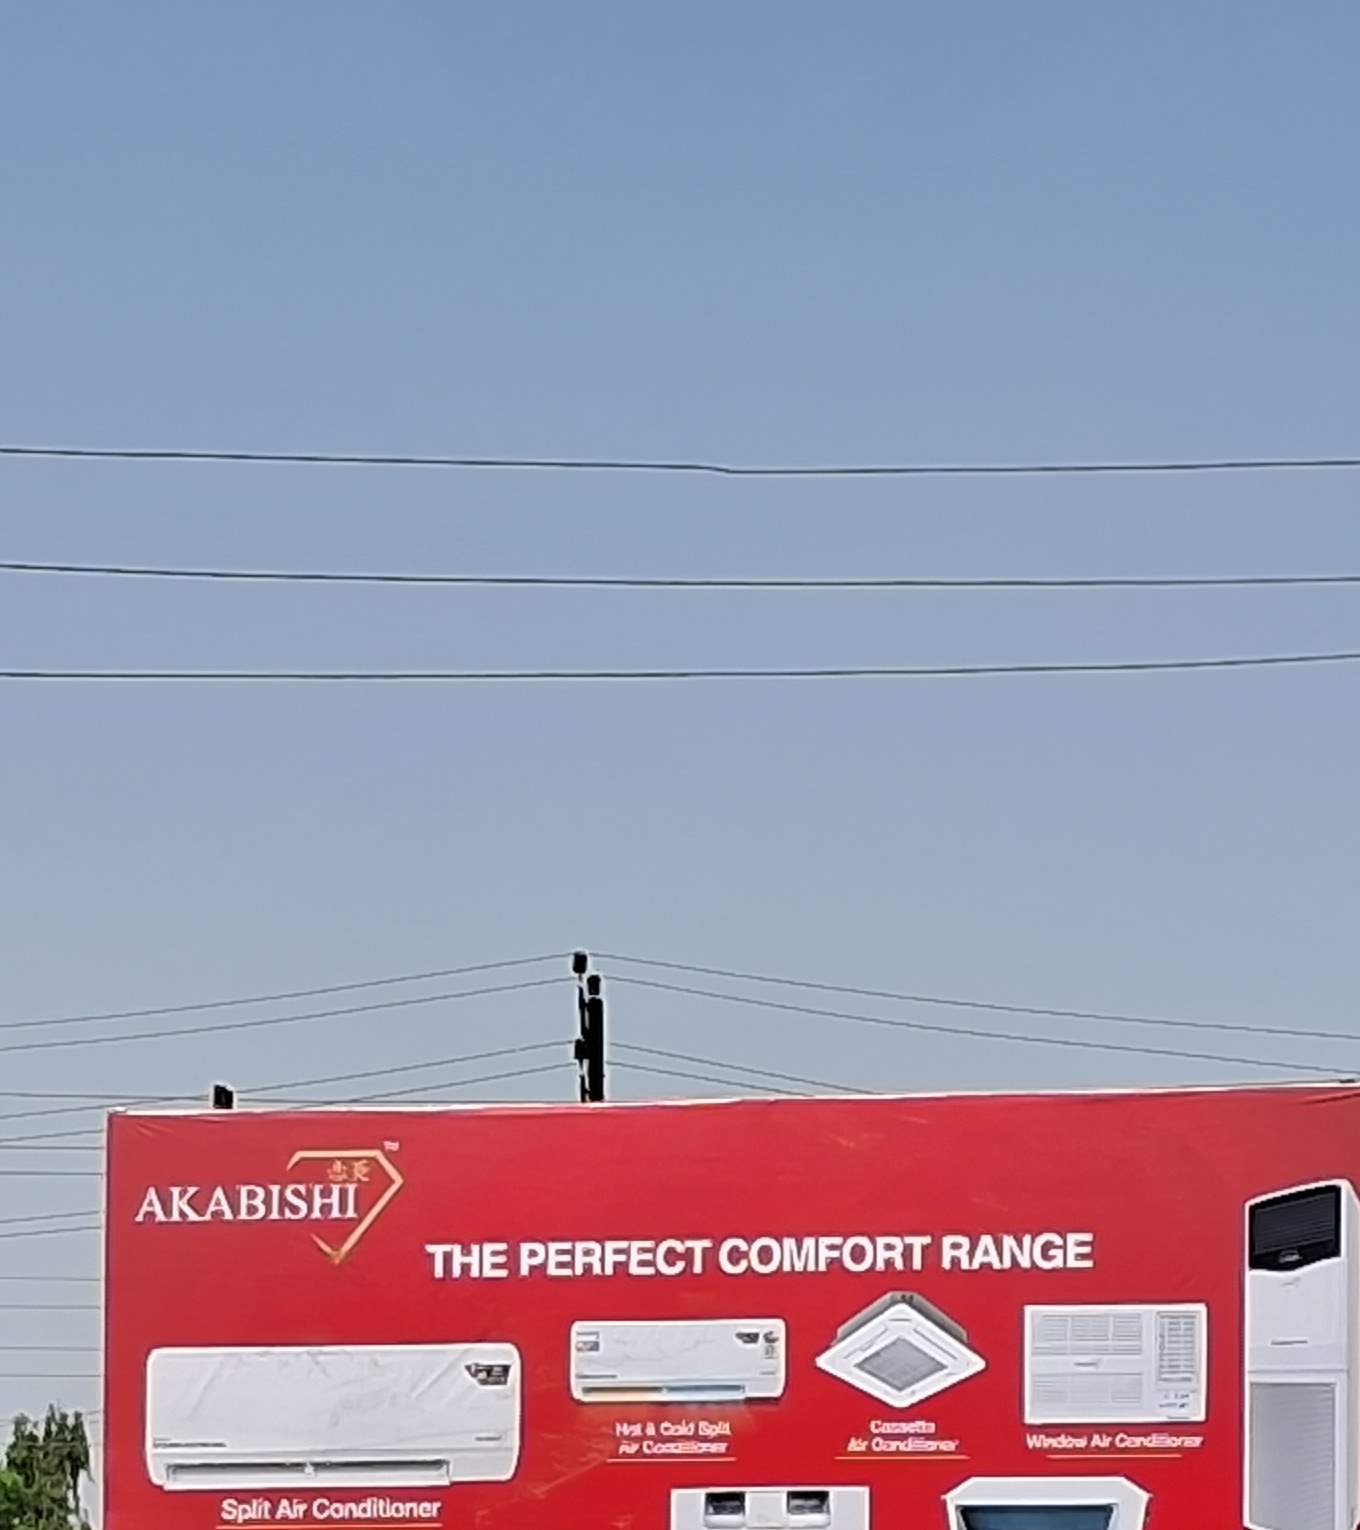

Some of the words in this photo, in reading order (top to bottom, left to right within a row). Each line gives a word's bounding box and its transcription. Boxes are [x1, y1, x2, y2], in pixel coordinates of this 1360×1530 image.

[134, 1183, 359, 1222] AKABISHI
[424, 1242, 509, 1279] THE
[519, 1238, 713, 1277] PERFECT
[717, 1235, 932, 1274] COMFORT
[941, 1232, 1094, 1270] RANGE
[698, 1420, 732, 1438] Split
[869, 1419, 936, 1434] Cassette
[618, 1440, 640, 1455] Air
[642, 1440, 729, 1454] Conditioner
[846, 1437, 869, 1452] Air
[870, 1436, 959, 1452] Conditioner
[1026, 1433, 1088, 1449] Window
[1090, 1433, 1112, 1448] Air
[1114, 1432, 1204, 1449] Conditioner
[220, 1497, 272, 1523] Split
[275, 1498, 308, 1520] Air
[312, 1497, 442, 1520] Conditioner
